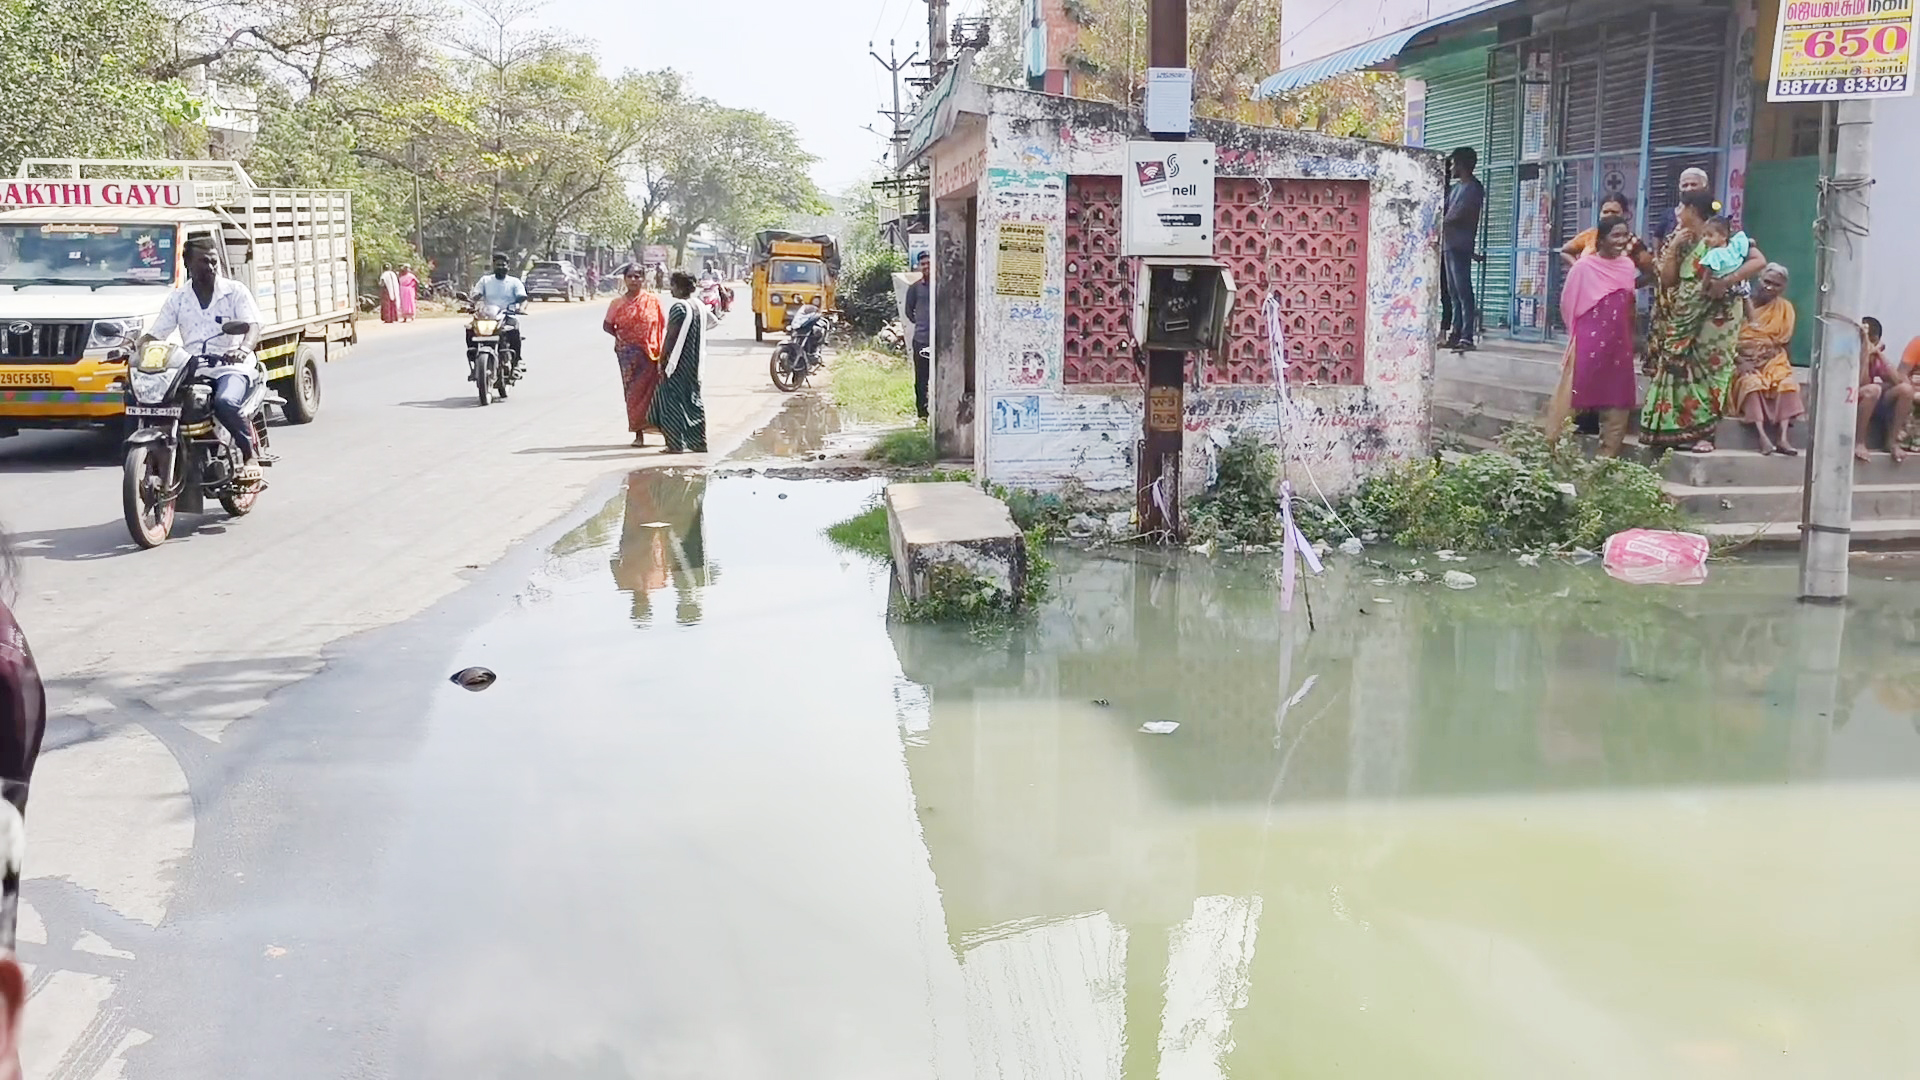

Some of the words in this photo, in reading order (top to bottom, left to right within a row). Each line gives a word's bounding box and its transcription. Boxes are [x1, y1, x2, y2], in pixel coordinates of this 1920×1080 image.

[1804, 26, 1908, 58] 650
[1779, 79, 1838, 95] 88778
[1843, 76, 1904, 93] 83302
[0, 183, 92, 205] AKTHI
[102, 184, 181, 206] GAYU
[1172, 184, 1197, 196] nell
[0, 373, 51, 385] 29CF5855
